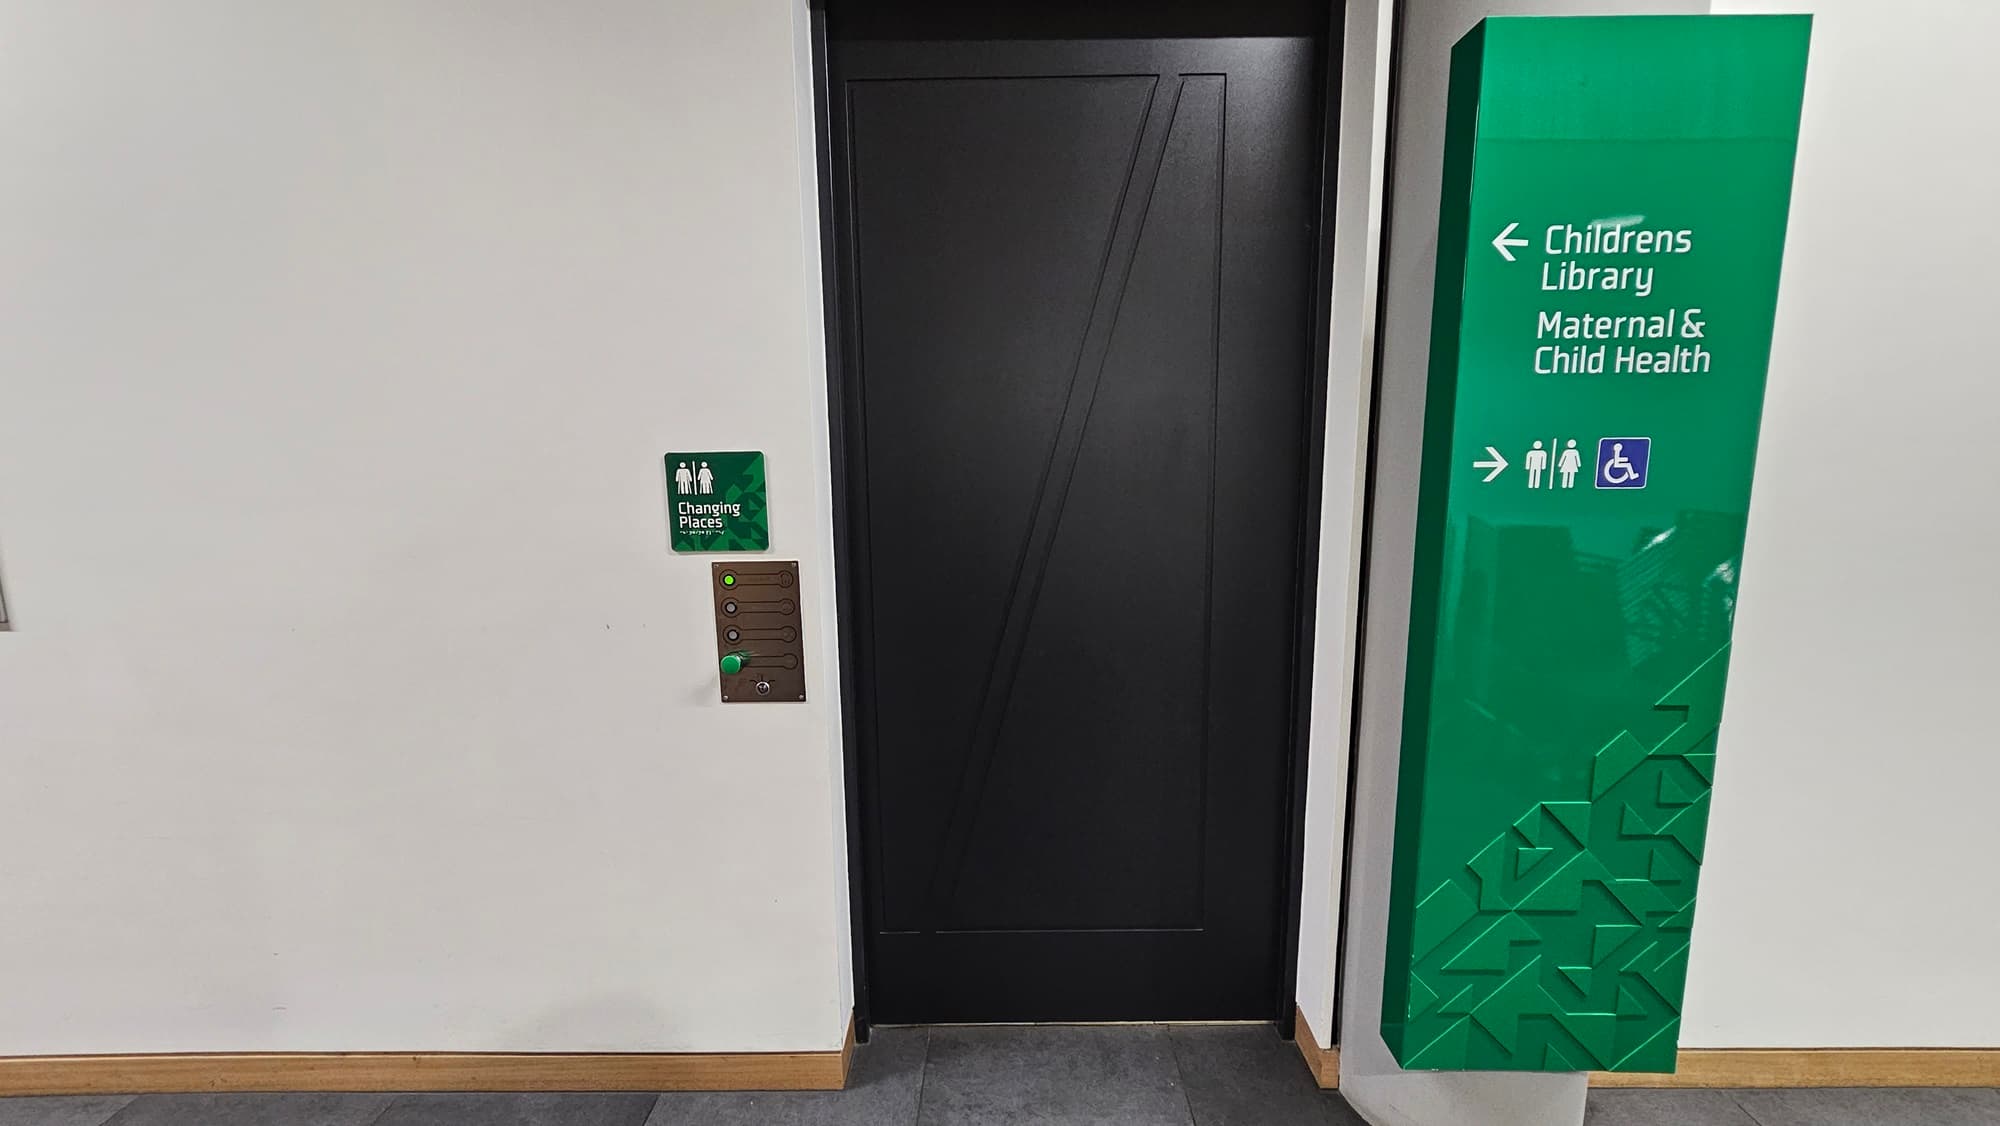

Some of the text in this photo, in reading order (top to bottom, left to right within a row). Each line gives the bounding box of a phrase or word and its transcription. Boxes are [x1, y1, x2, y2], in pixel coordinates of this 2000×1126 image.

[1546, 223, 1692, 254] Childrens
[1541, 261, 1654, 297] Library
[1537, 308, 1706, 339] Maternal &
[1534, 344, 1711, 374] Child Health
[678, 502, 741, 517] Changing
[679, 516, 723, 529] Places
